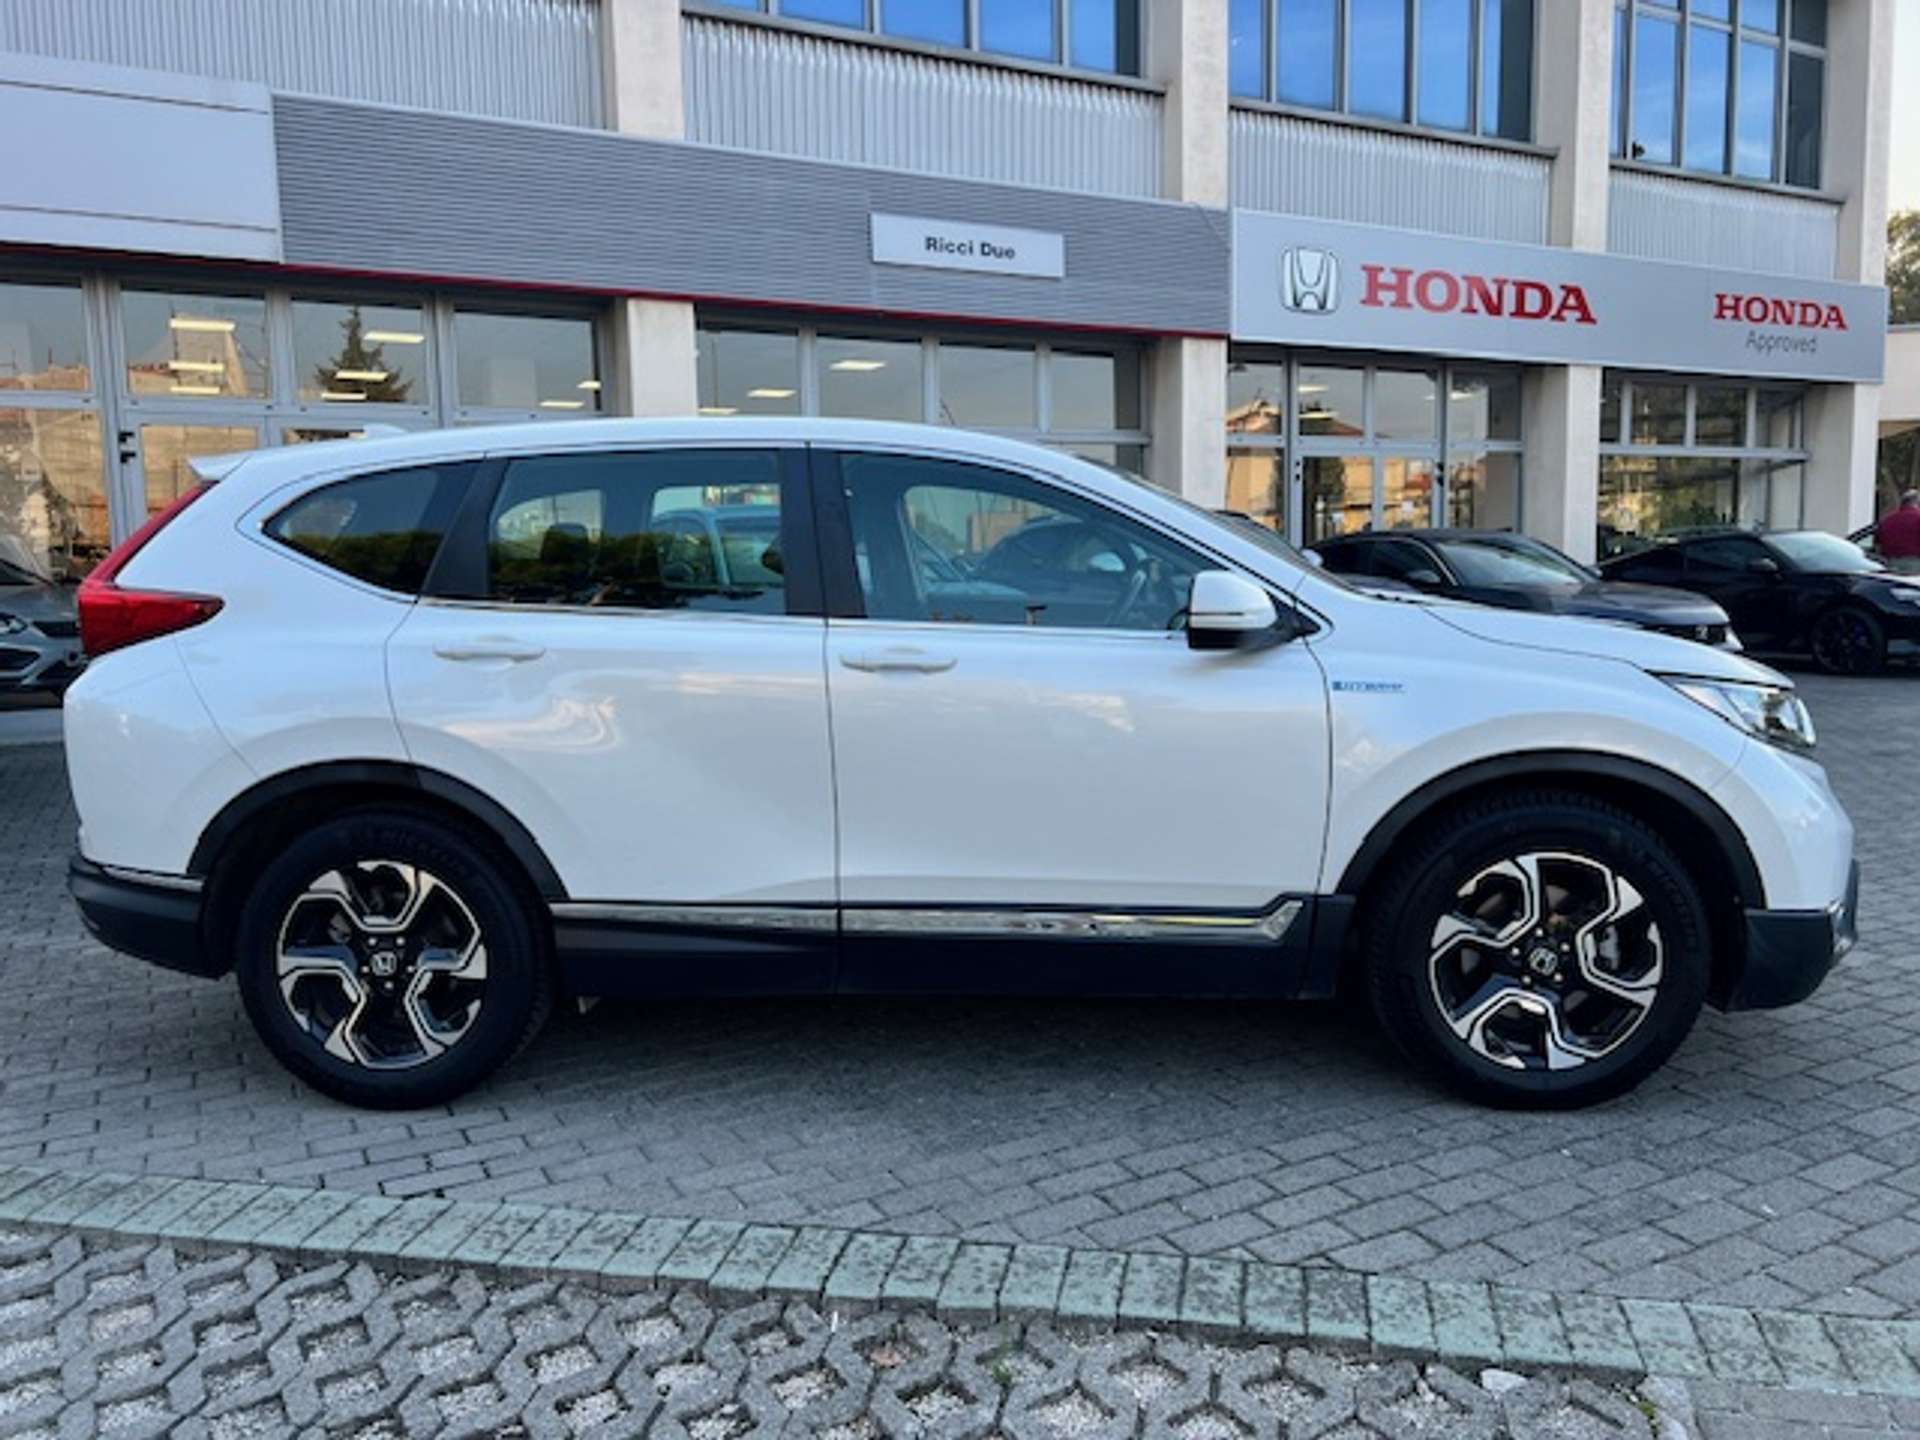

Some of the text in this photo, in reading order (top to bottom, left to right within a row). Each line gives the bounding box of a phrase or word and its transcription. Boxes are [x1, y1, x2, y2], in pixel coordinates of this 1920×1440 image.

[925, 236, 1016, 259] Ricci Due
[1360, 264, 1597, 325] HONDA
[1714, 293, 1849, 331] HONDA
[1746, 329, 1818, 355] Approved
